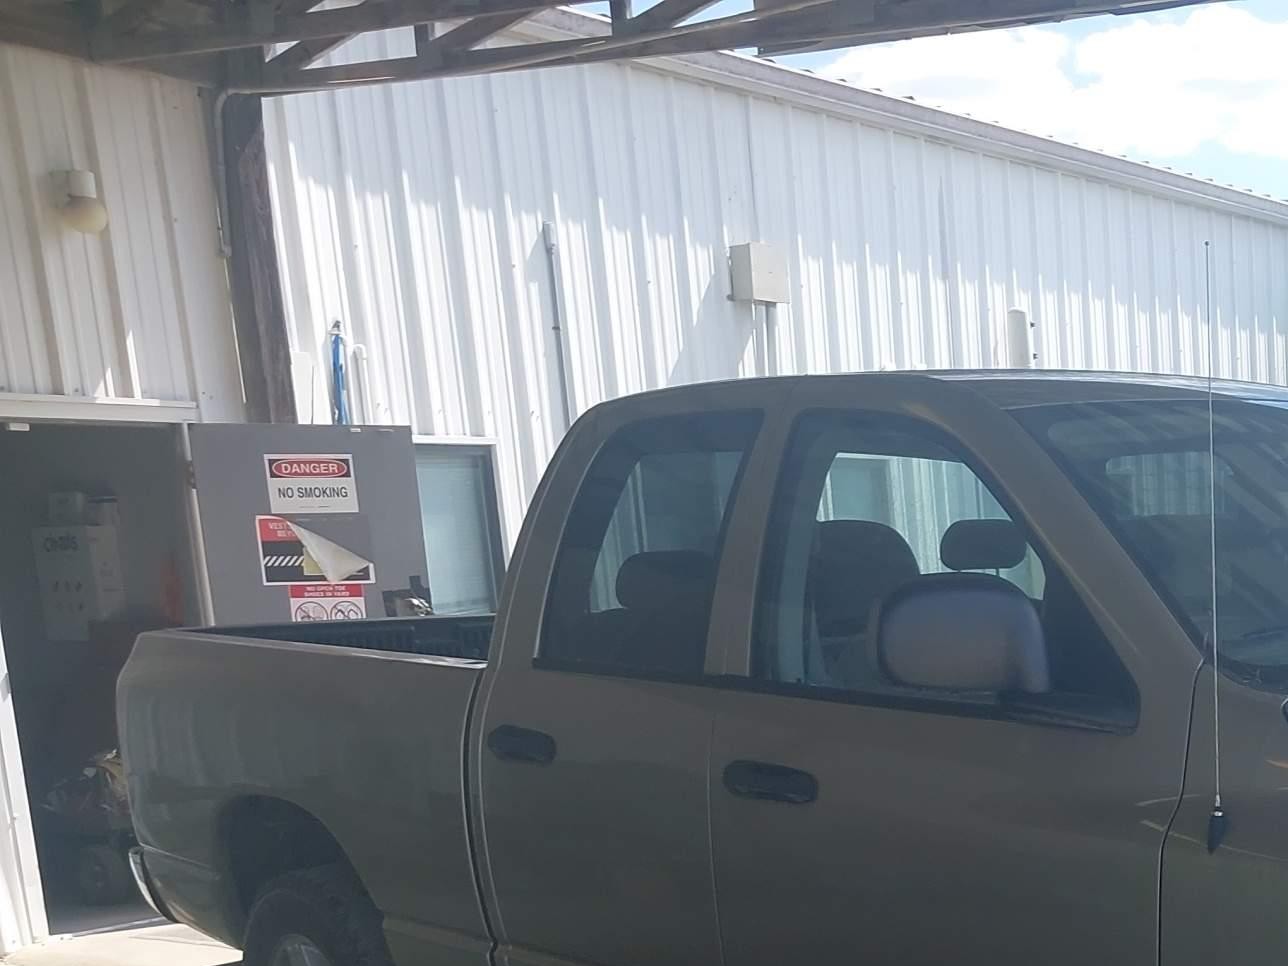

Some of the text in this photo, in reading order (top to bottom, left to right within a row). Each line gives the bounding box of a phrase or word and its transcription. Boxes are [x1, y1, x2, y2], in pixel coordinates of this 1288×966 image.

[281, 464, 338, 473] DANGER
[278, 486, 348, 498] NO SMOKING
